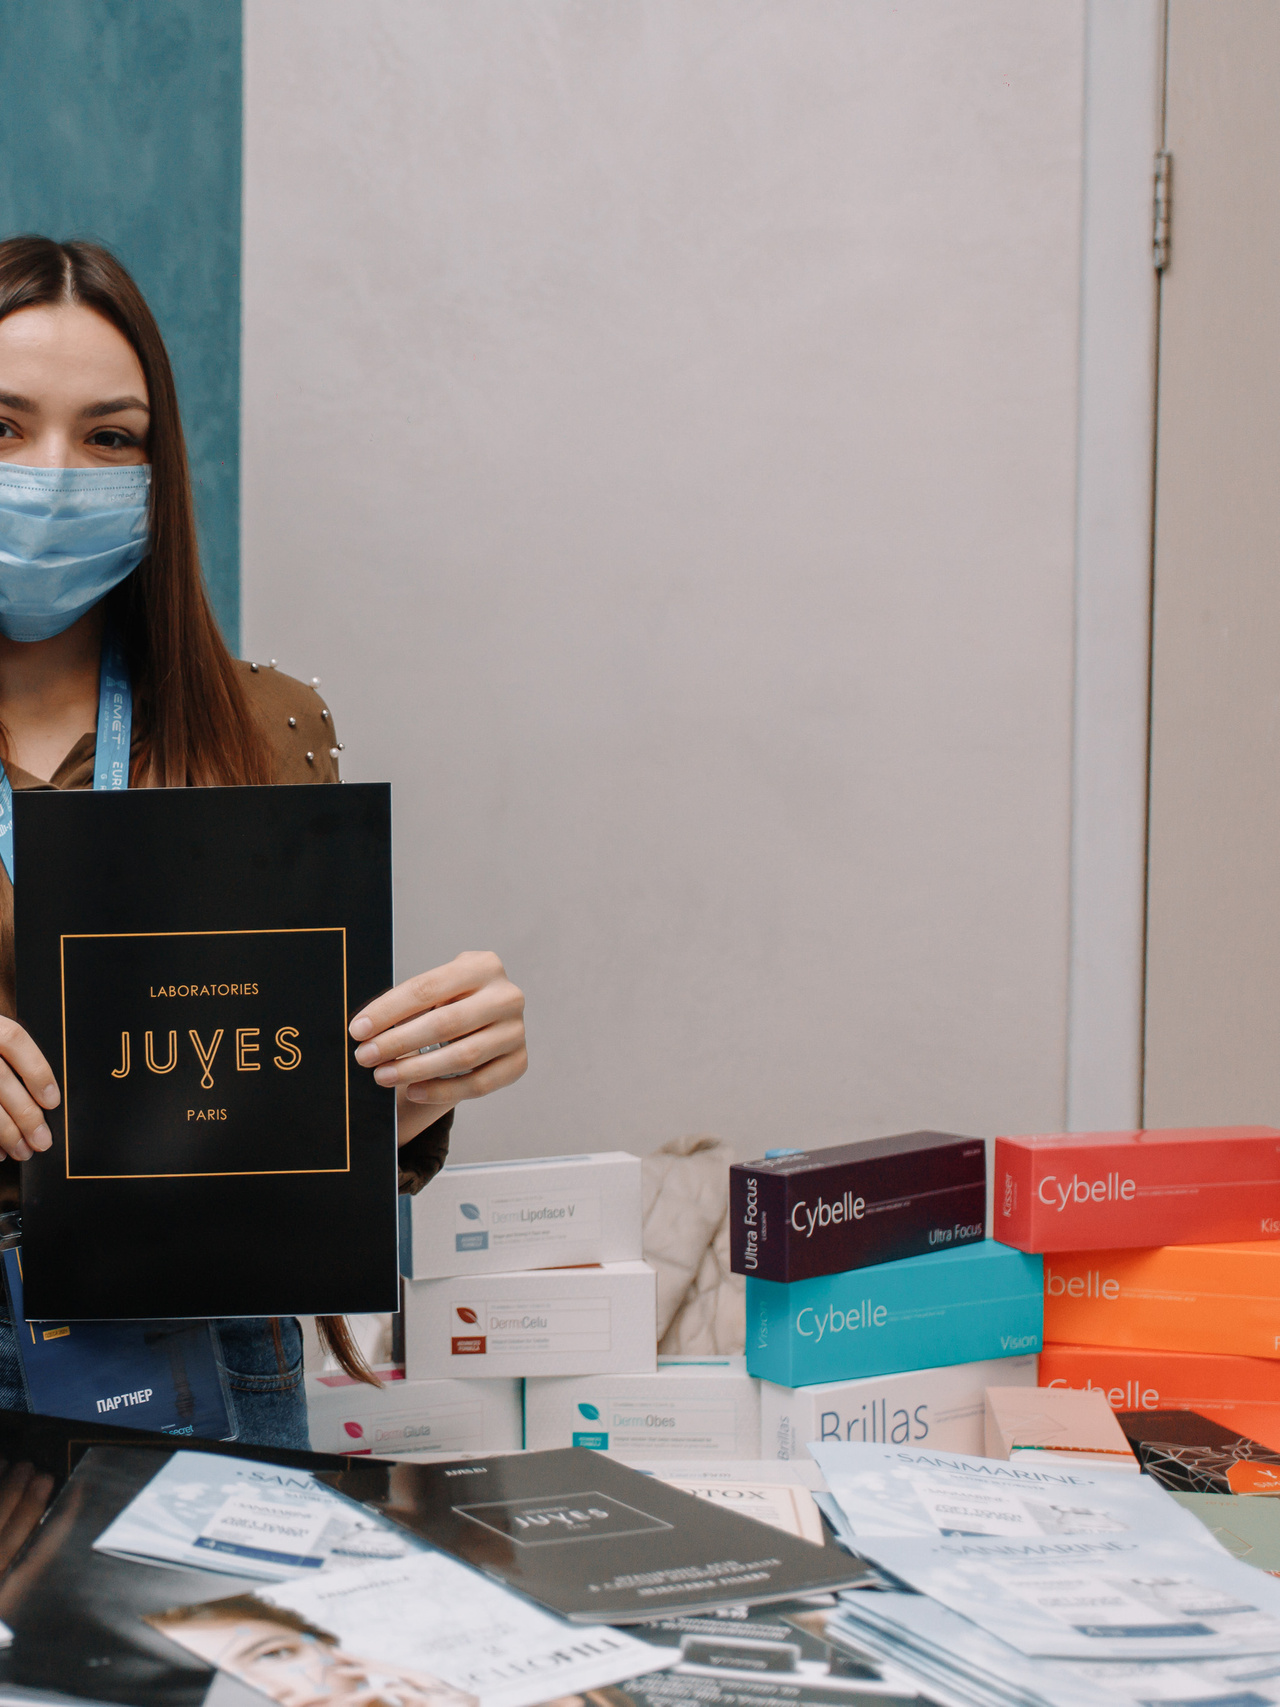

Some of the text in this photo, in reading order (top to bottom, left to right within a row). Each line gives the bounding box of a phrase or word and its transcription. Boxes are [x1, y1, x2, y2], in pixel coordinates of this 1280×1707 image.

[150, 983, 259, 997] LABORATORIES
[111, 1026, 303, 1089] JUVES
[187, 1109, 228, 1121] PARIS
[568, 1204, 575, 1217] V
[1002, 1173, 1012, 1218] Kisser
[1038, 1172, 1136, 1211] Cybelle
[745, 1178, 758, 1269] Ultra Focus
[791, 1191, 865, 1238] Cybelle
[929, 1223, 982, 1245] Ultra Focus
[1046, 1269, 1120, 1300] belle
[758, 1301, 767, 1350] Vision
[796, 1299, 888, 1343] Cybelle
[1000, 1334, 1038, 1350] Vision
[96, 1388, 153, 1413] ПАРТНЕР
[777, 1415, 790, 1461] Brillas
[821, 1398, 928, 1444] Brillas
[896, 1452, 1086, 1485] SANMARINE
